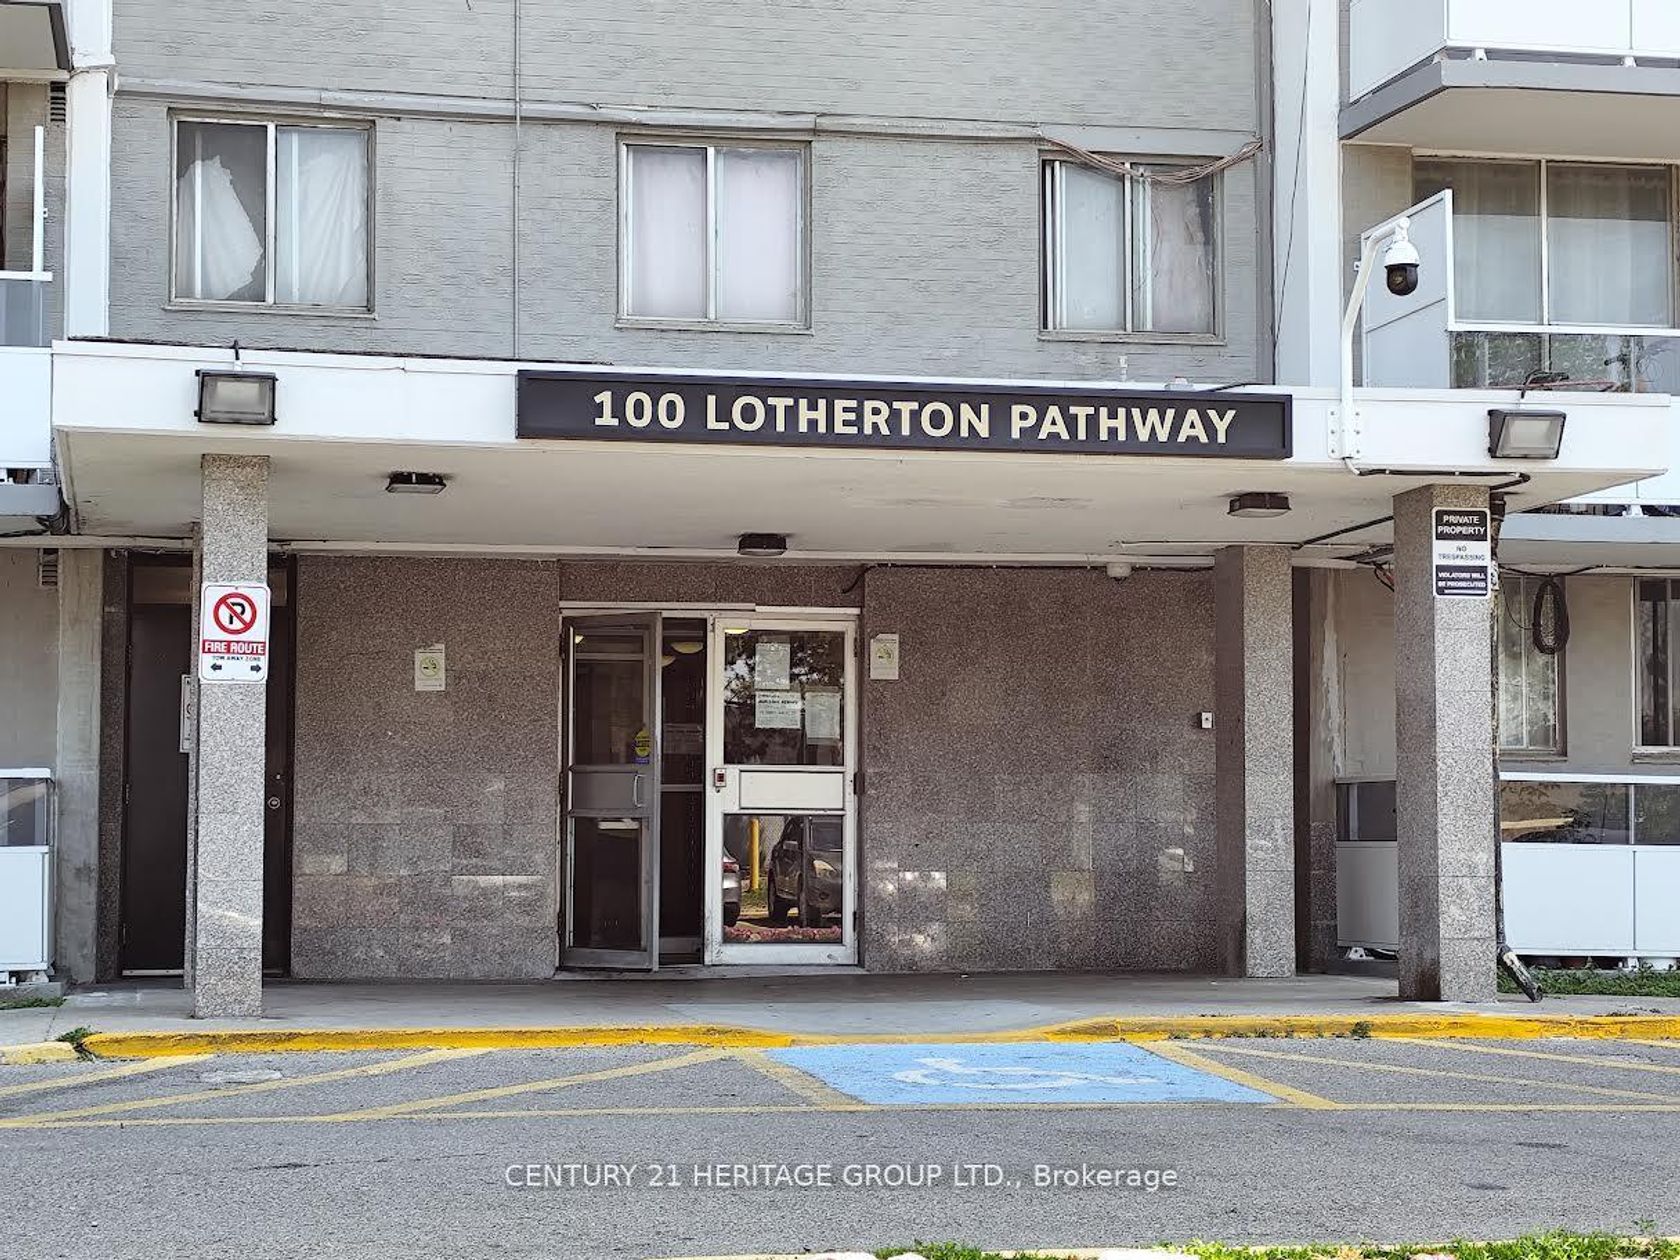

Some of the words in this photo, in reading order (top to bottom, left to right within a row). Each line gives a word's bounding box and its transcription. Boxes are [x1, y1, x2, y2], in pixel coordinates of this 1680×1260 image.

[593, 391, 686, 429] 100
[706, 394, 990, 438] LOTHERTON
[1011, 403, 1237, 444] PATHWAY
[1443, 514, 1480, 524] PRIVATE
[1437, 525, 1486, 535] PROPERTY
[1438, 553, 1486, 561] TRESPASSING
[204, 642, 228, 653] FIRE
[230, 642, 265, 654] ROUTE
